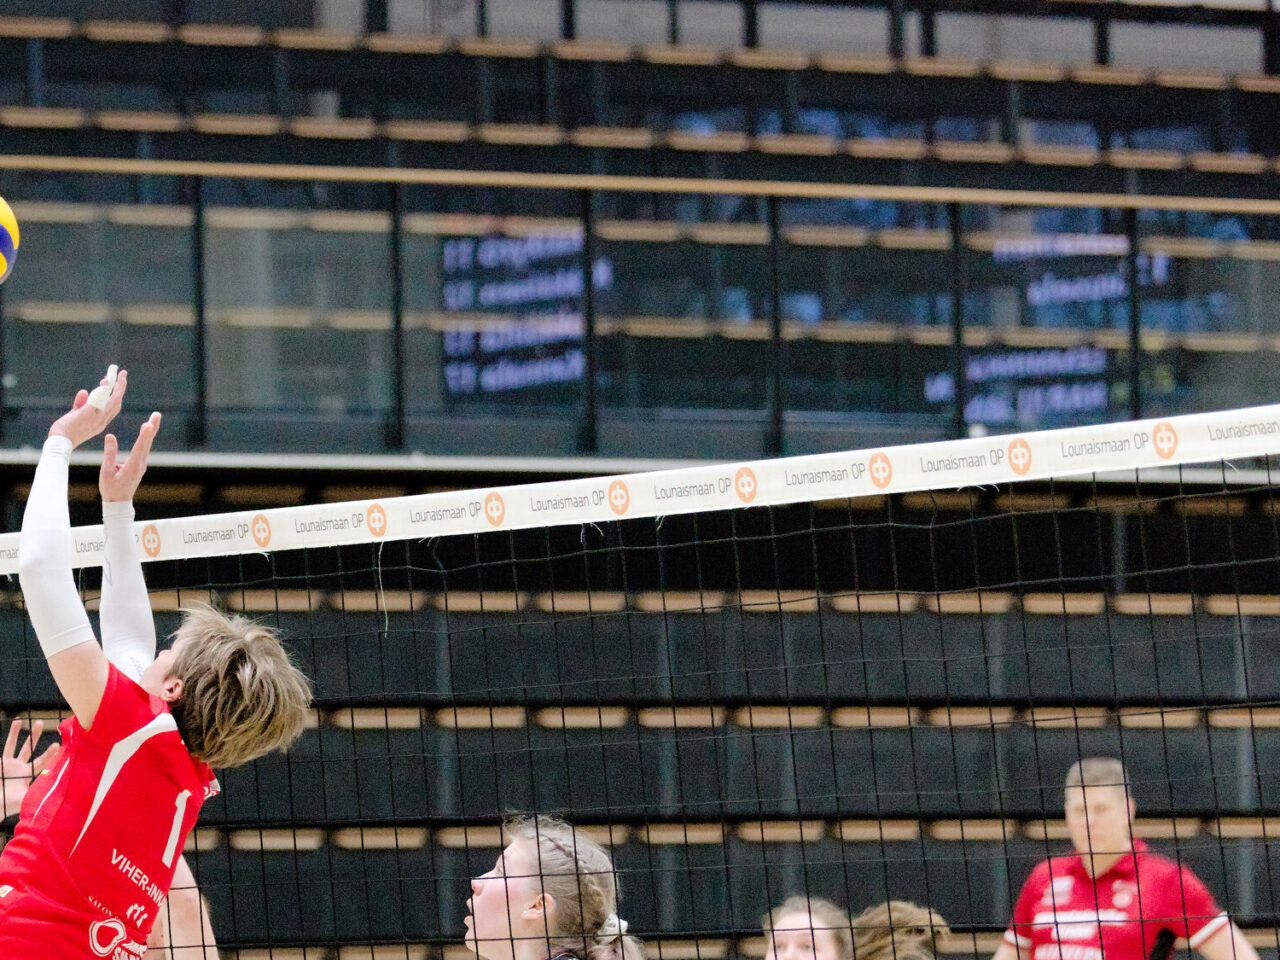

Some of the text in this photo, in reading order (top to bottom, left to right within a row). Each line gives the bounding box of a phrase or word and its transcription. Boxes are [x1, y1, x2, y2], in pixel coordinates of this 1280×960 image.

[1061, 434, 1149, 458] Lounaismaan OP
[921, 449, 1004, 473] Lounaismaan OP
[785, 463, 865, 486] Lounaismaan OP
[654, 477, 731, 500] Lounaismaan OP
[531, 490, 605, 512] Lounaismaan OP
[294, 513, 364, 534] Lounaismaan OP
[410, 502, 481, 523] Lounaismaan OP
[183, 523, 249, 544] Lounaismaan OP
